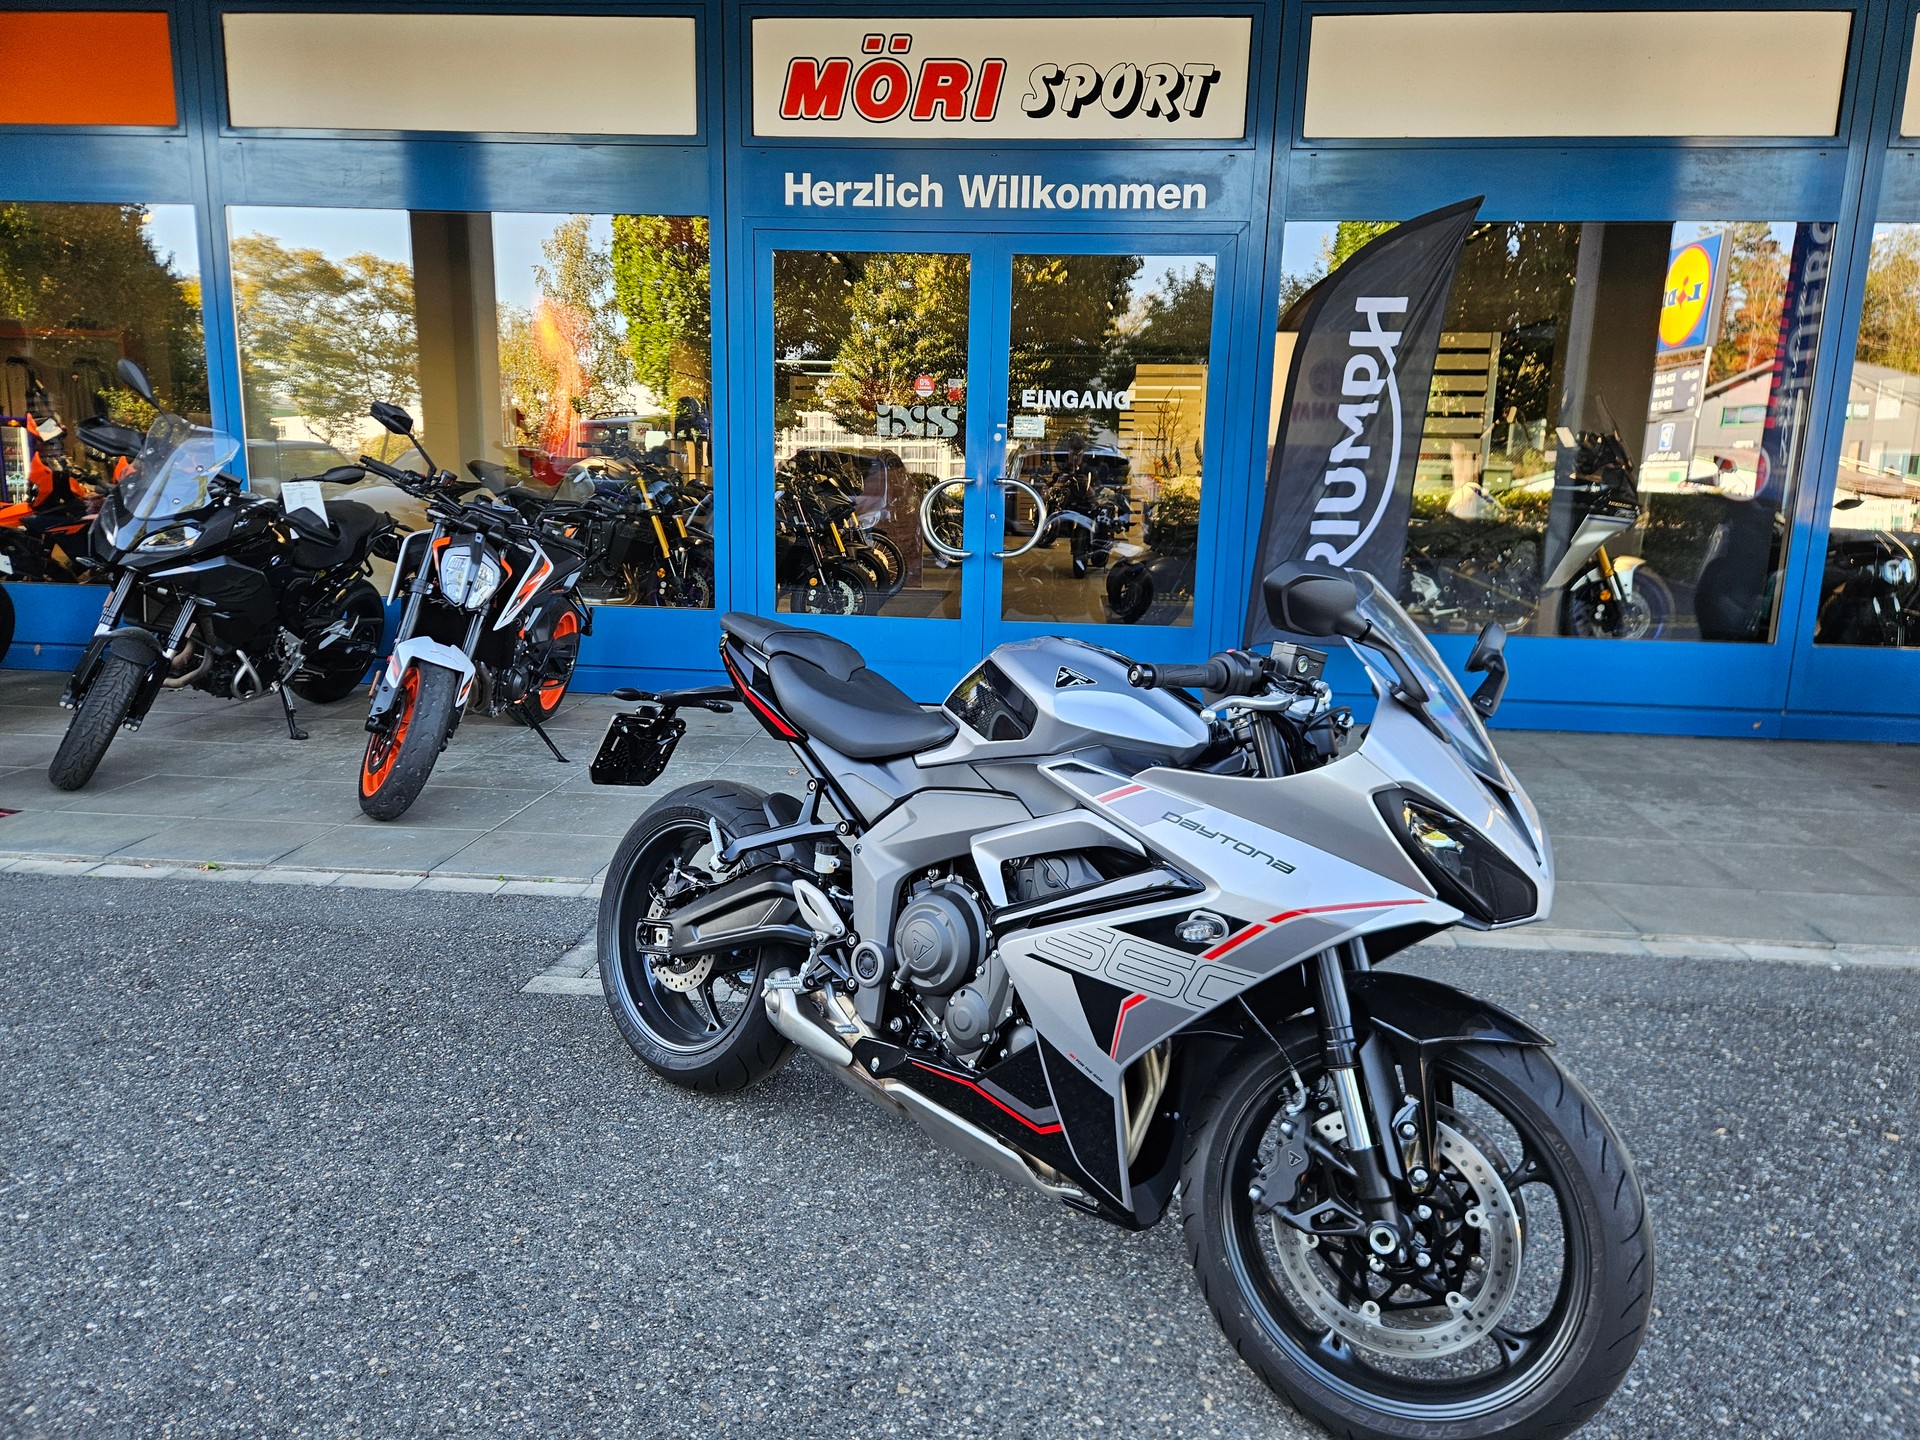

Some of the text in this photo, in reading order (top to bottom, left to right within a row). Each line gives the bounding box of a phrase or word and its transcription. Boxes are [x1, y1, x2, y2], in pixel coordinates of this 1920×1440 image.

[779, 34, 1221, 123] MÖRI SPORT
[784, 172, 1207, 209] Herzlich Willkommen
[1021, 389, 1131, 409] EINGANG
[1304, 296, 1409, 572] RIUMPH
[614, 1007, 670, 1065] METZELER
